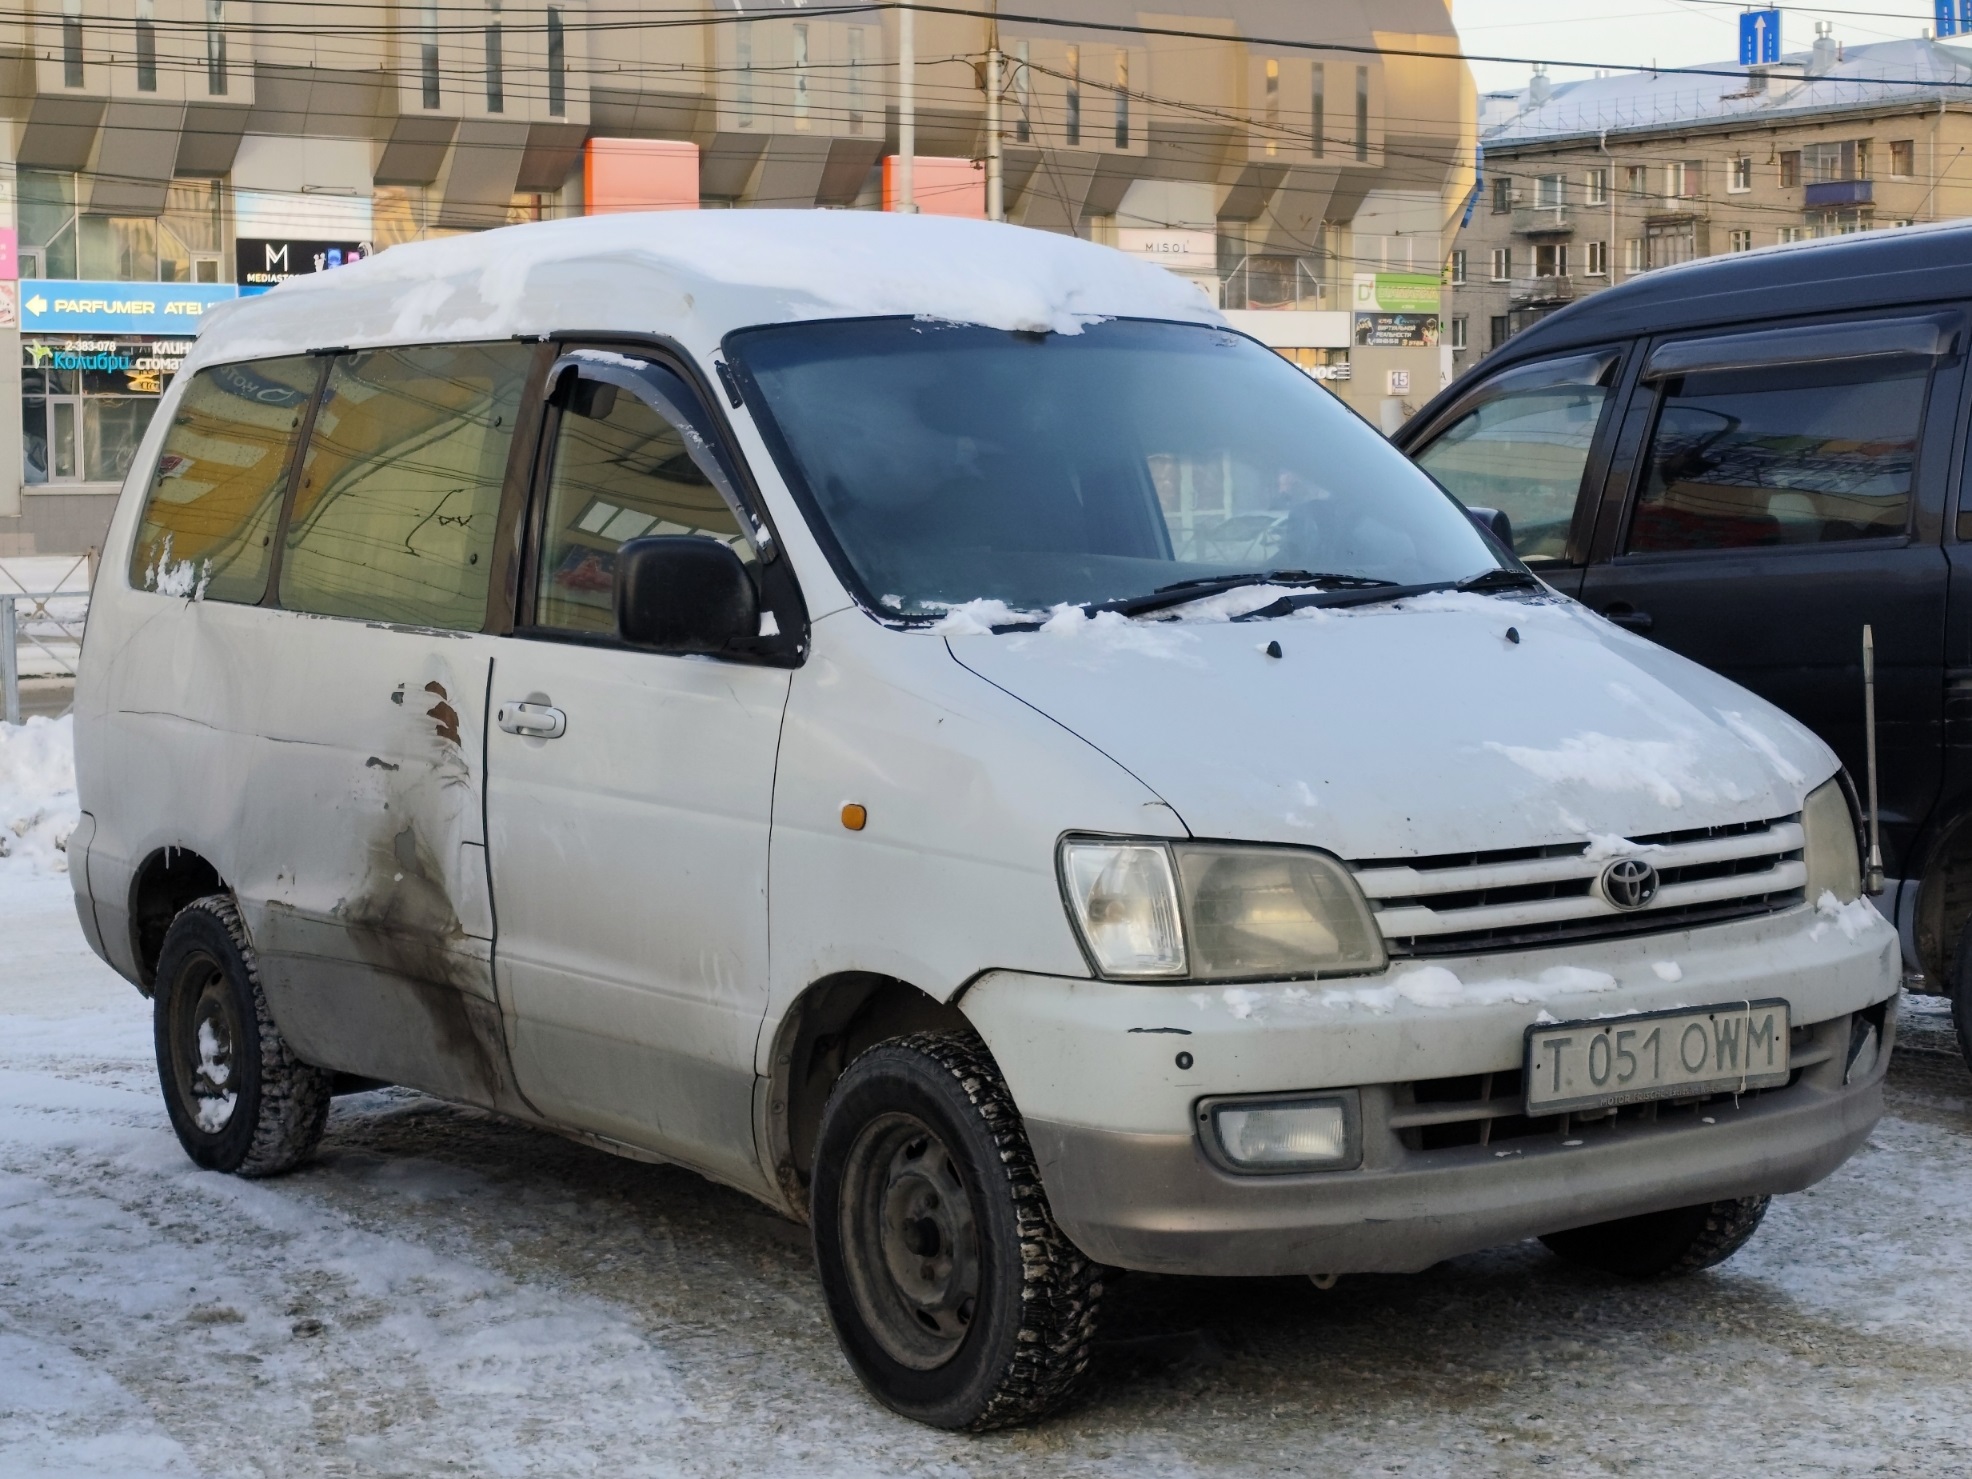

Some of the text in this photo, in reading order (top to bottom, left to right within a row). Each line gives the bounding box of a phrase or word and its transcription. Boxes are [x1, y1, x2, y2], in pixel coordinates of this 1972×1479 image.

[1145, 243, 1189, 253] MISOL
[265, 243, 288, 271] M
[247, 273, 300, 283] MEDIAST
[54, 299, 214, 315] PARFUMER ATEL
[65, 341, 116, 351] 2-383-078
[54, 353, 129, 373] Колибри
[1392, 372, 1408, 386] 15
[1543, 1037, 1572, 1093] T
[1588, 1027, 1661, 1087] 051
[1600, 1094, 1630, 1106] MOTOR
